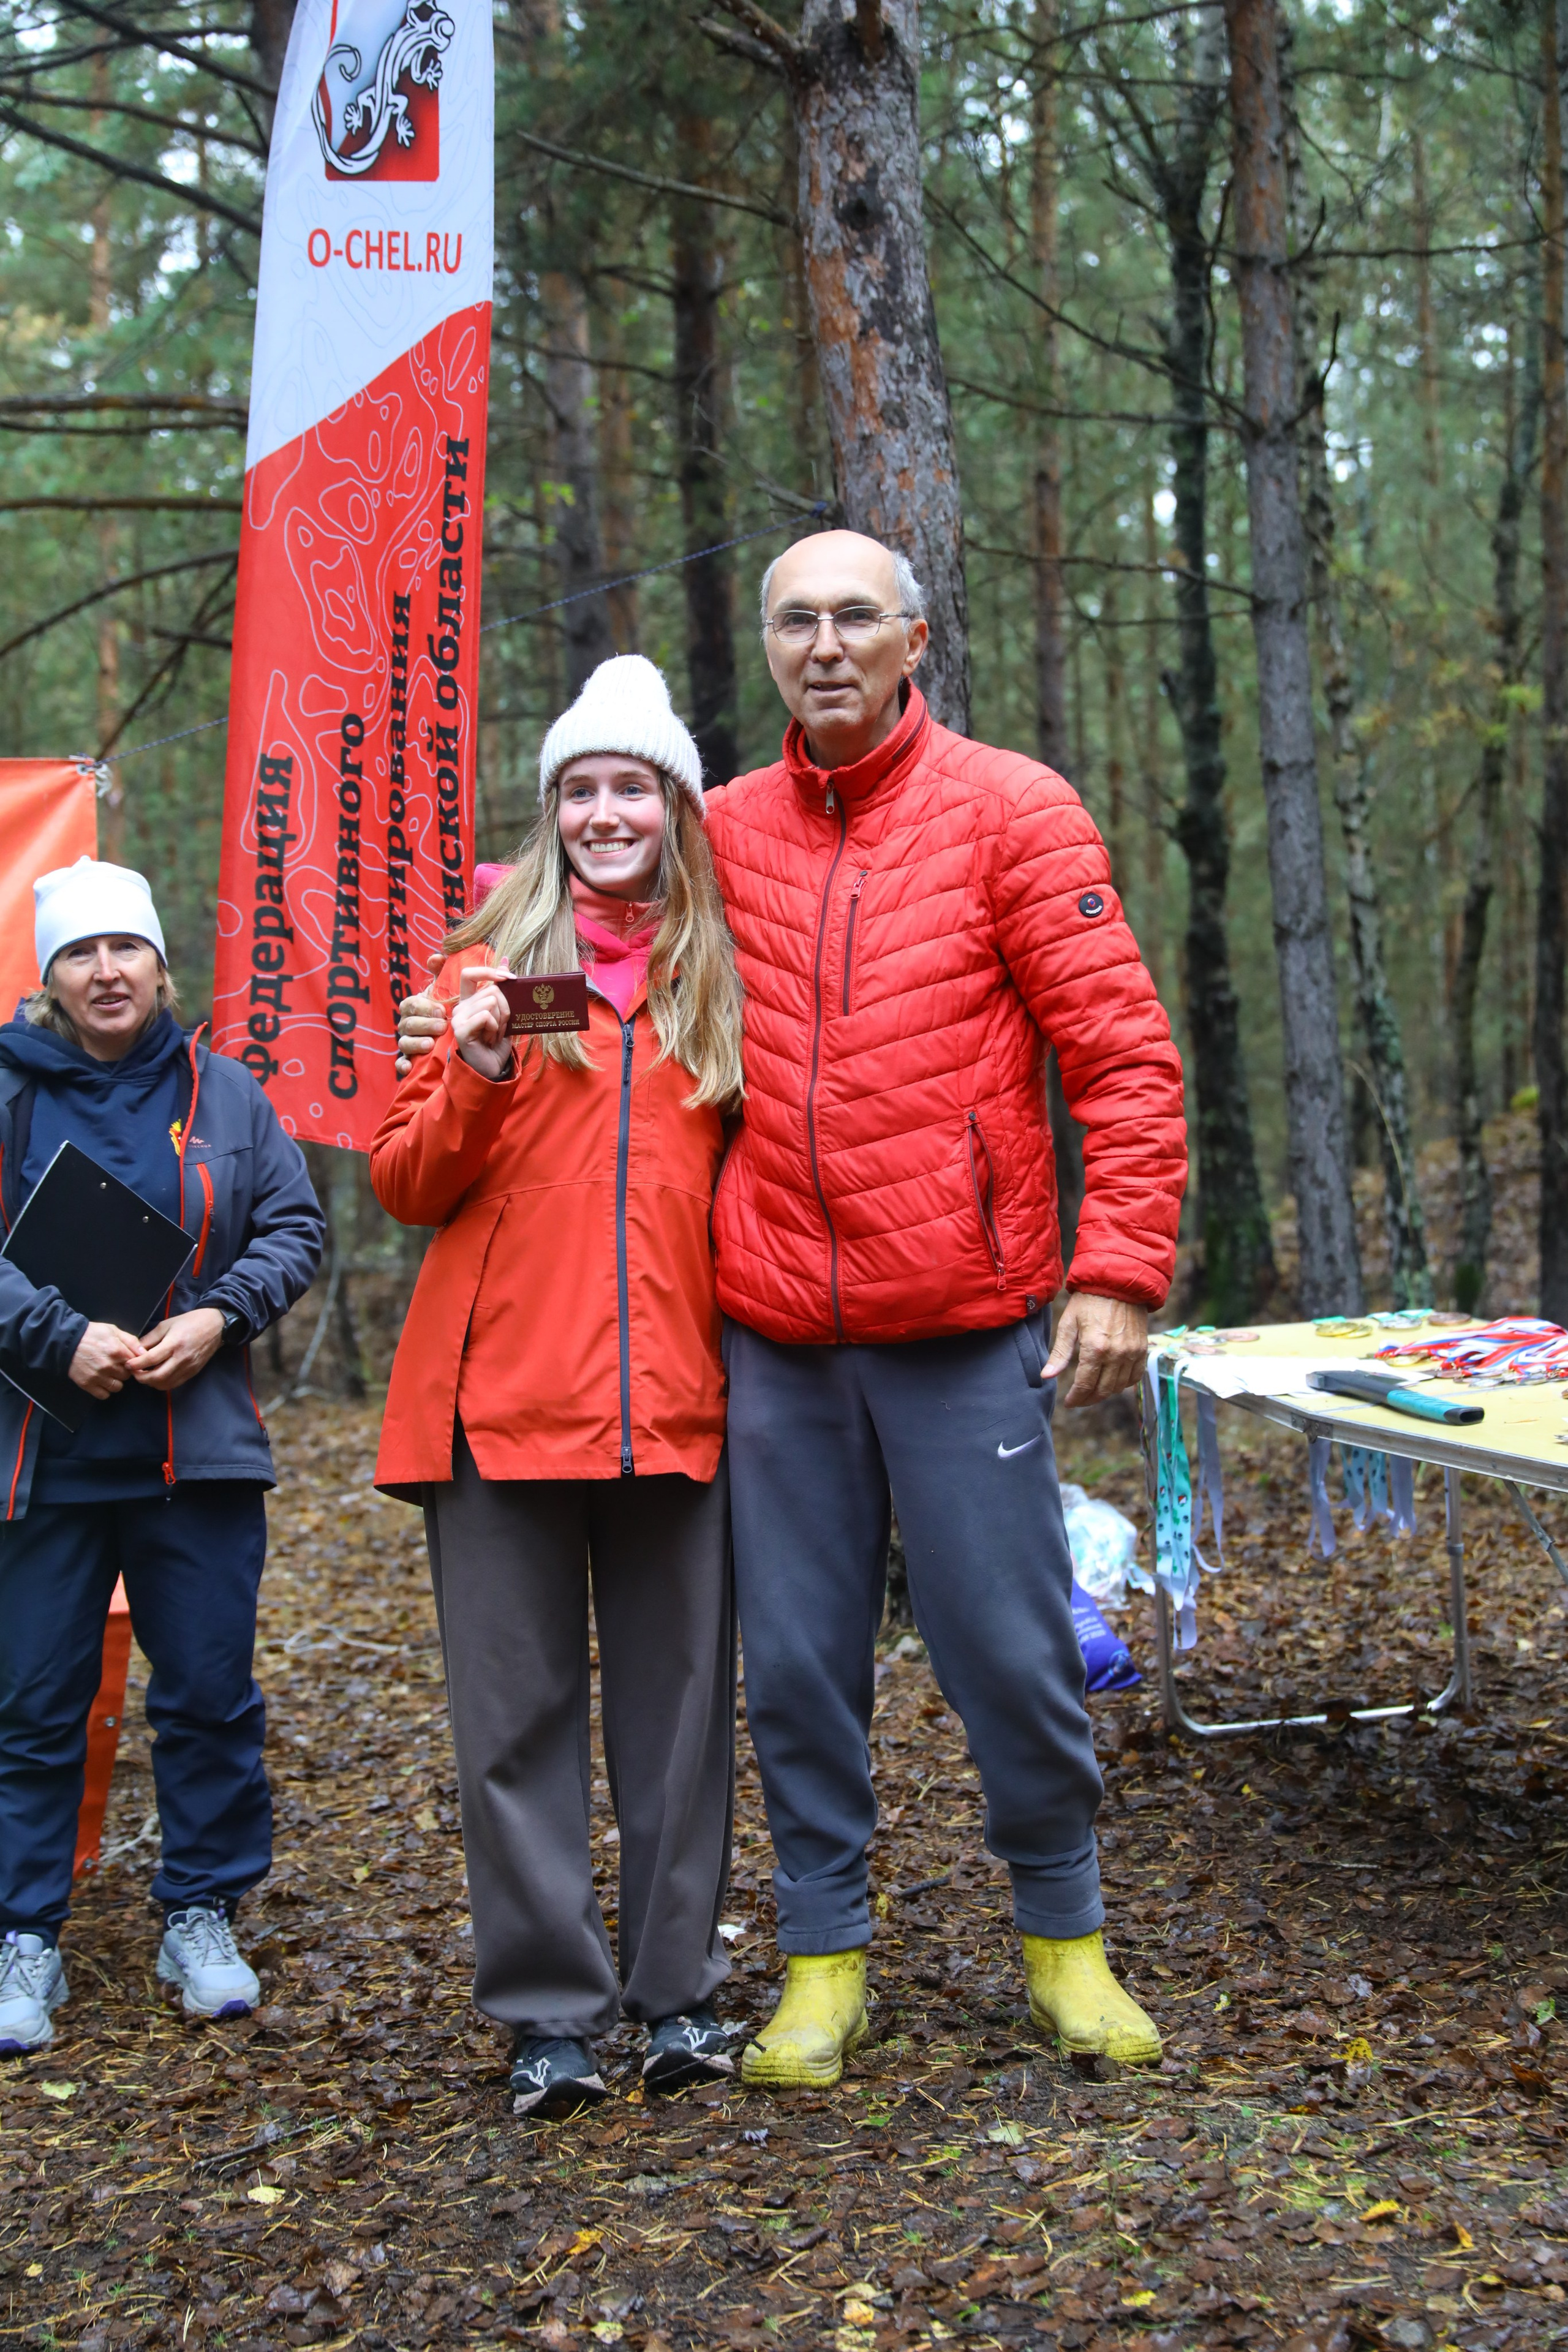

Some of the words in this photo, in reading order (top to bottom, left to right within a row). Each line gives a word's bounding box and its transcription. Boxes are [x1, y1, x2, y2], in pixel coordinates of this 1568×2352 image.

[307, 228, 462, 274] O-CHEL.RU
[427, 435, 469, 672] области
[436, 674, 459, 710] о
[232, 753, 297, 1088] Федерация
[326, 713, 371, 1099] спортивного
[387, 591, 413, 1082] ентирования
[515, 1011, 575, 1022] УДОСТОВЕРЕНИЕ
